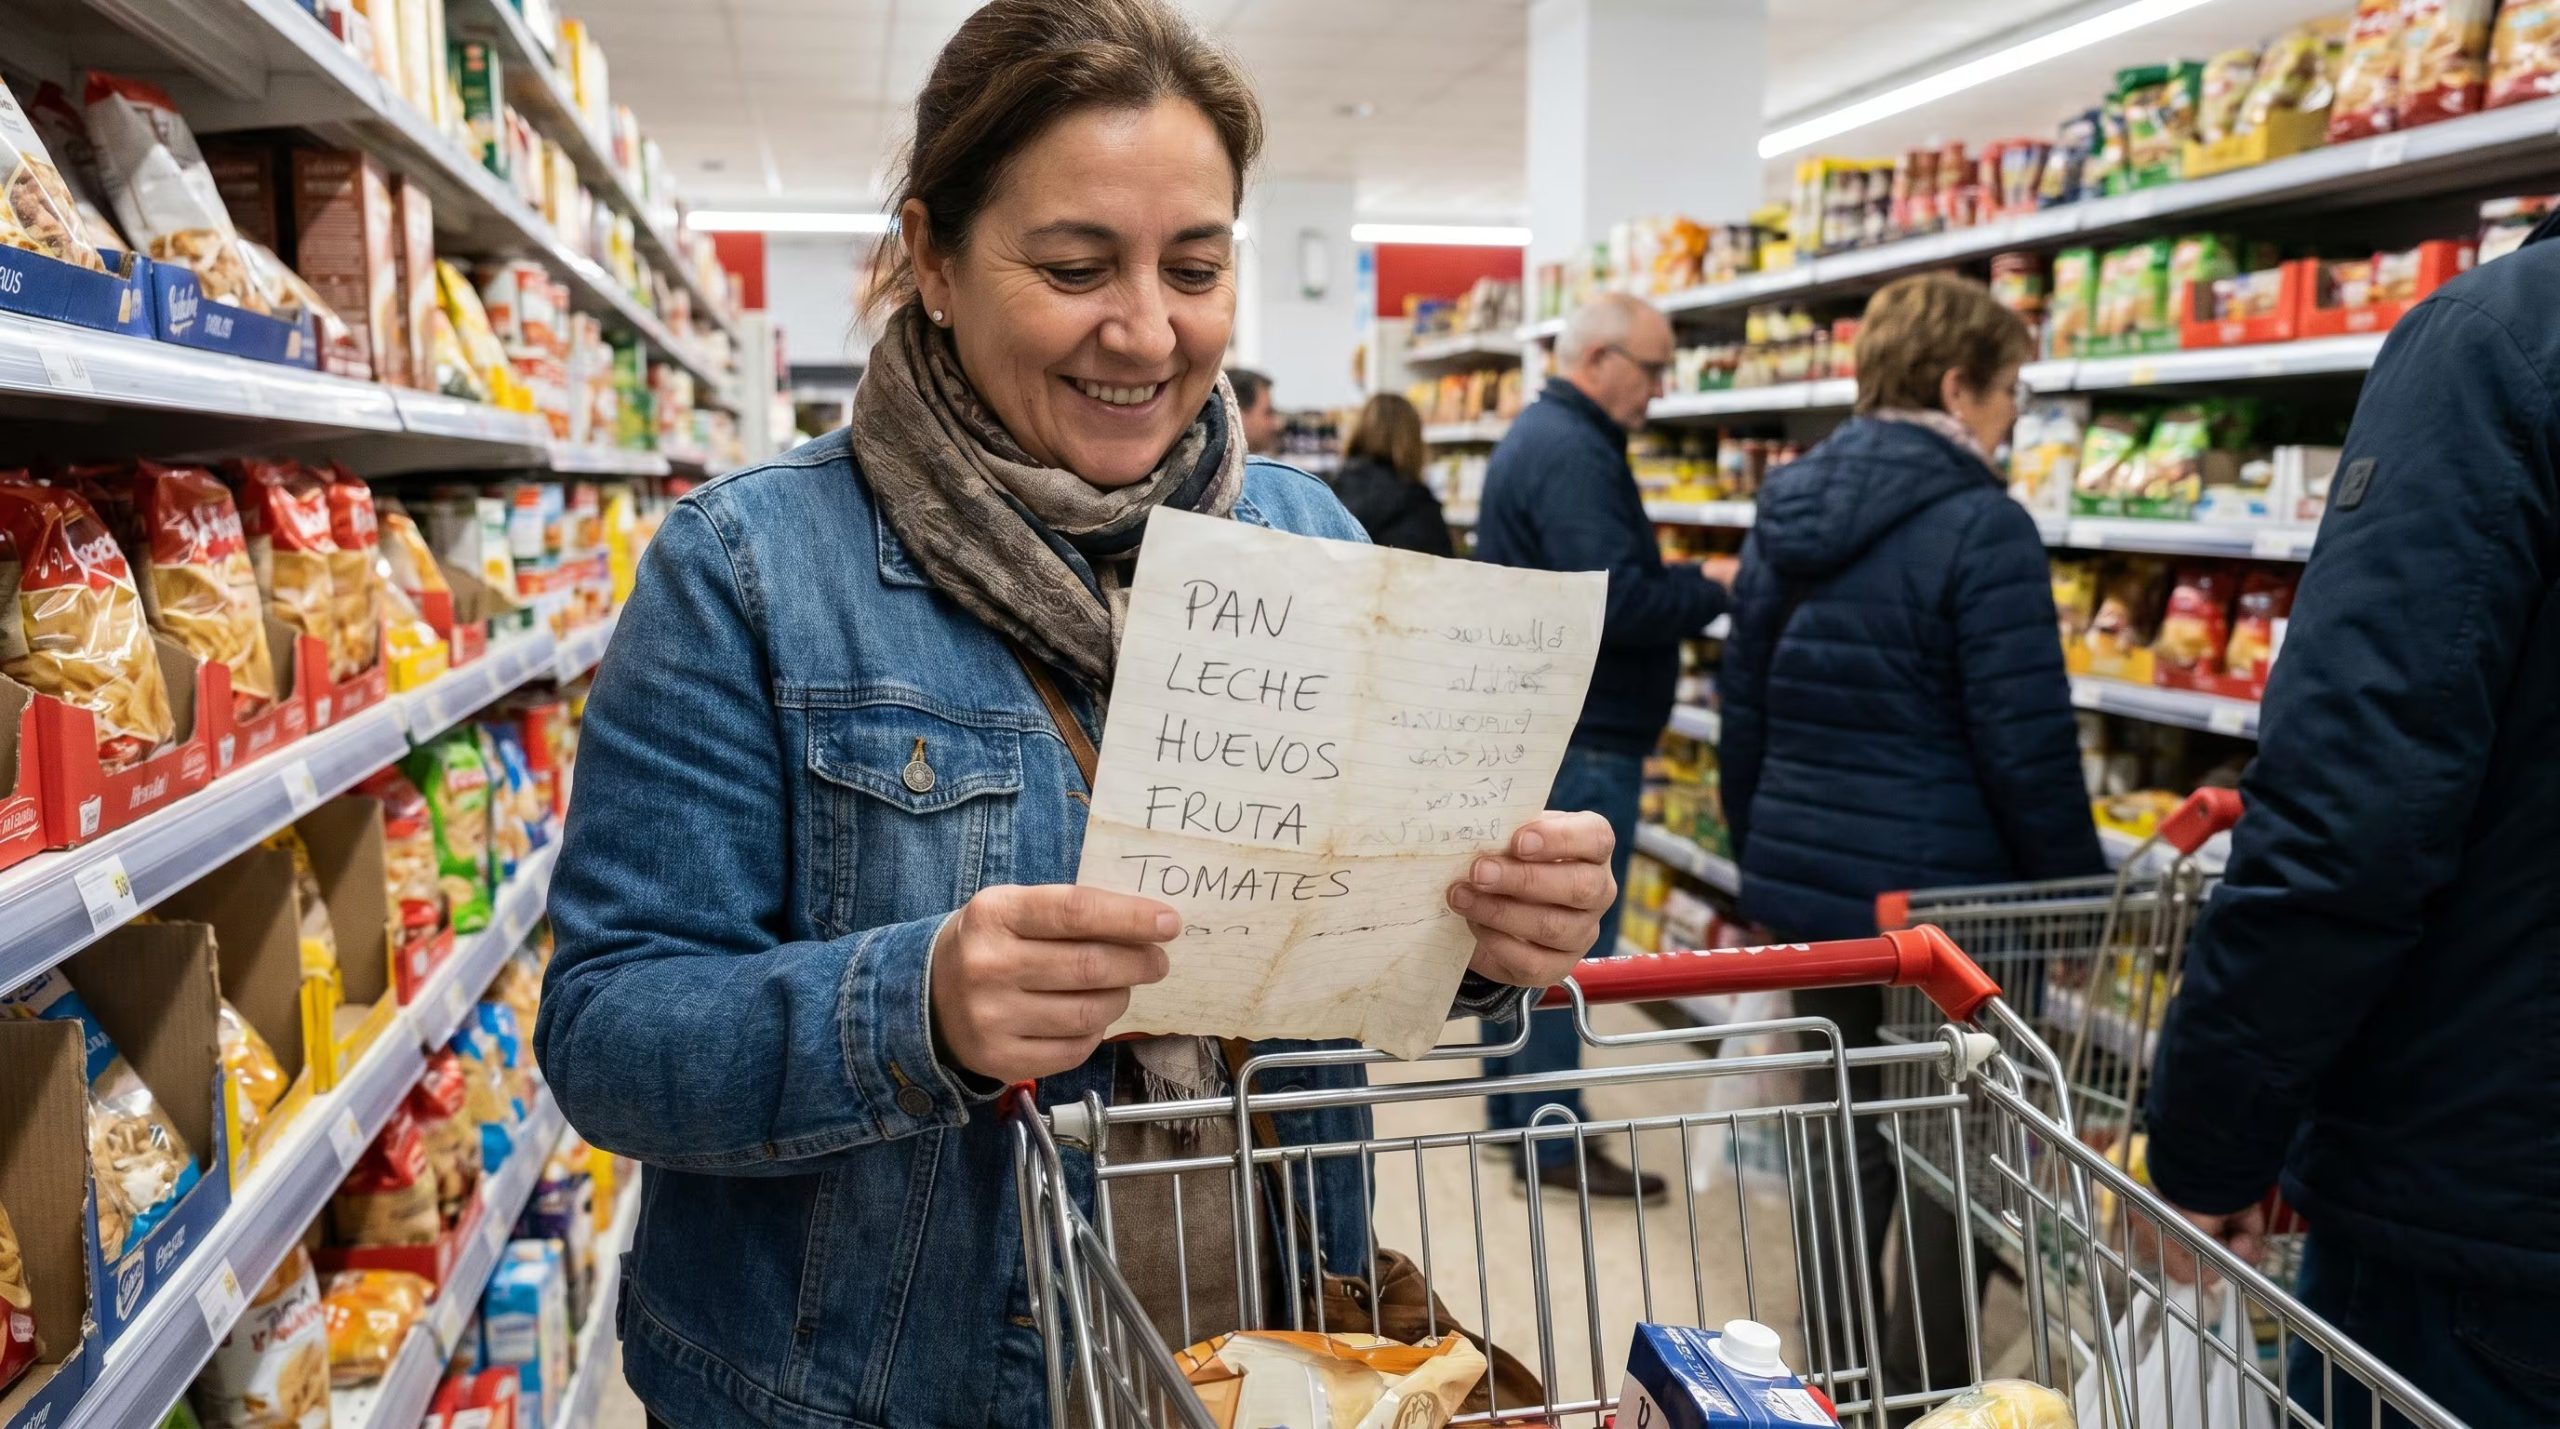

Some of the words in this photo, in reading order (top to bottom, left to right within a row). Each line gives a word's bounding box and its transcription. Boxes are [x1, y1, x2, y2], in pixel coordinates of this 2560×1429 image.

[1183, 579, 1293, 638] PAN
[1166, 652, 1329, 712] LECHE
[1155, 713, 1340, 781] HUEVOS
[1146, 784, 1308, 846] FRUTA
[1120, 853, 1352, 901] TOMATES
